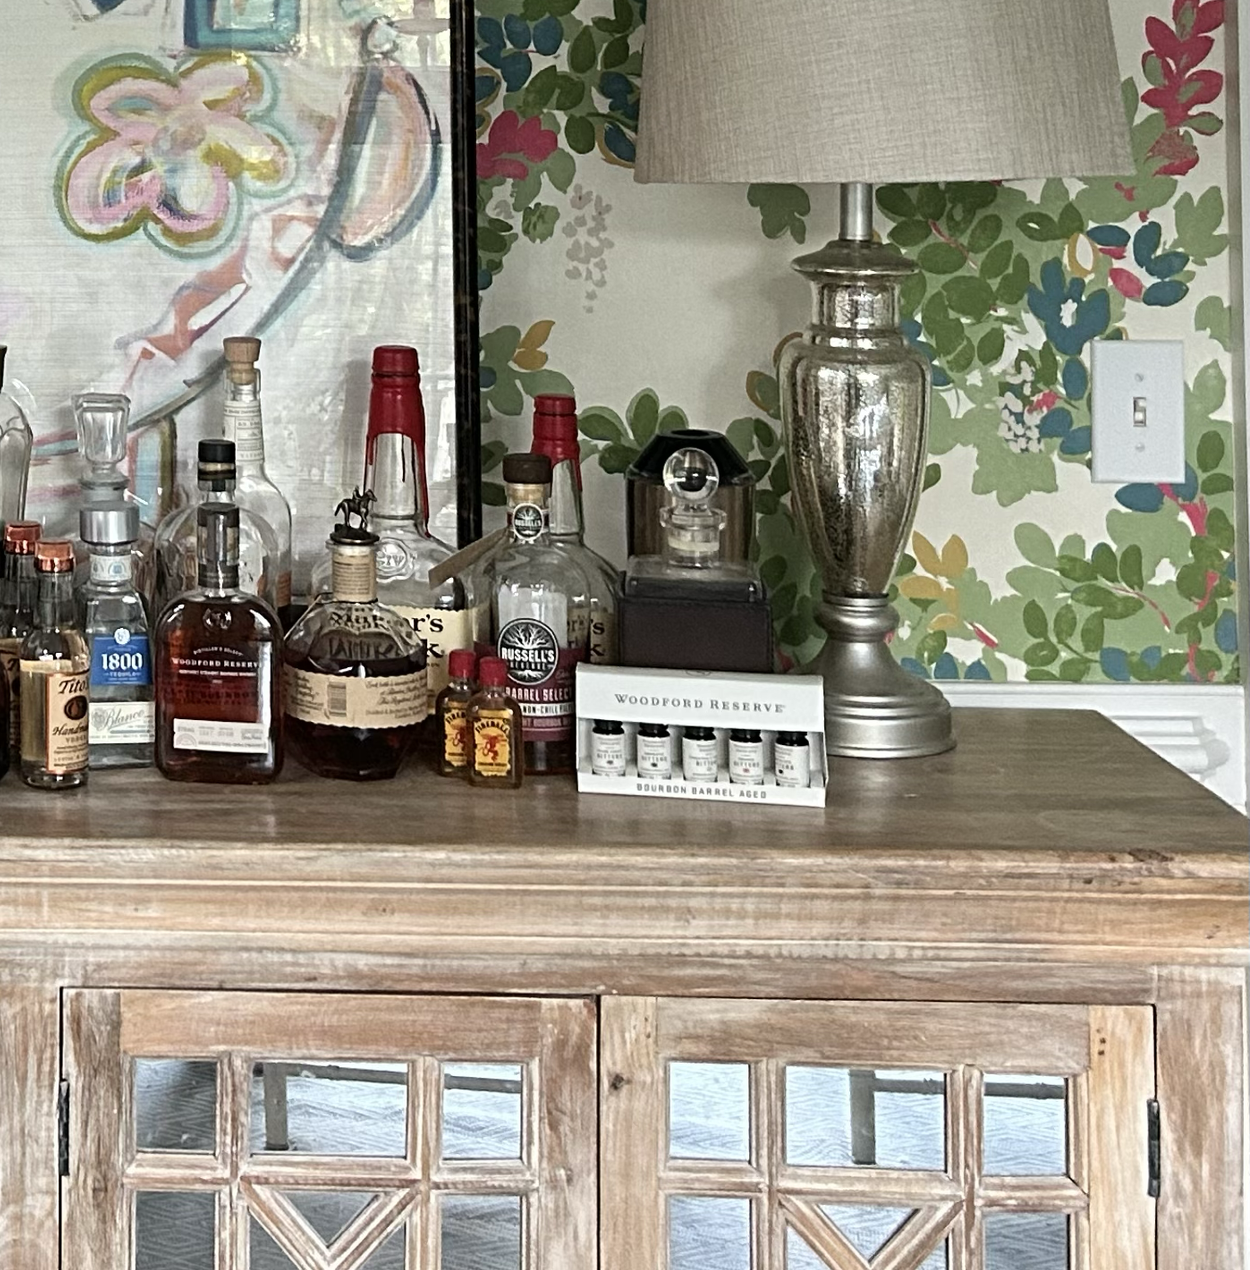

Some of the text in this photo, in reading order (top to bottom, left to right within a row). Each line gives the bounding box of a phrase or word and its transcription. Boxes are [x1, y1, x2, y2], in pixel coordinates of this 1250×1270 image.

[101, 652, 143, 672] 1800
[172, 657, 221, 667] WOODFORD
[502, 647, 555, 663] RUSSELL'S
[505, 686, 540, 702] BARREL
[615, 693, 784, 714] WOODFORD RESERVE
[103, 706, 145, 729] Blanco
[636, 782, 768, 800] BOURBON BARREL AGED
